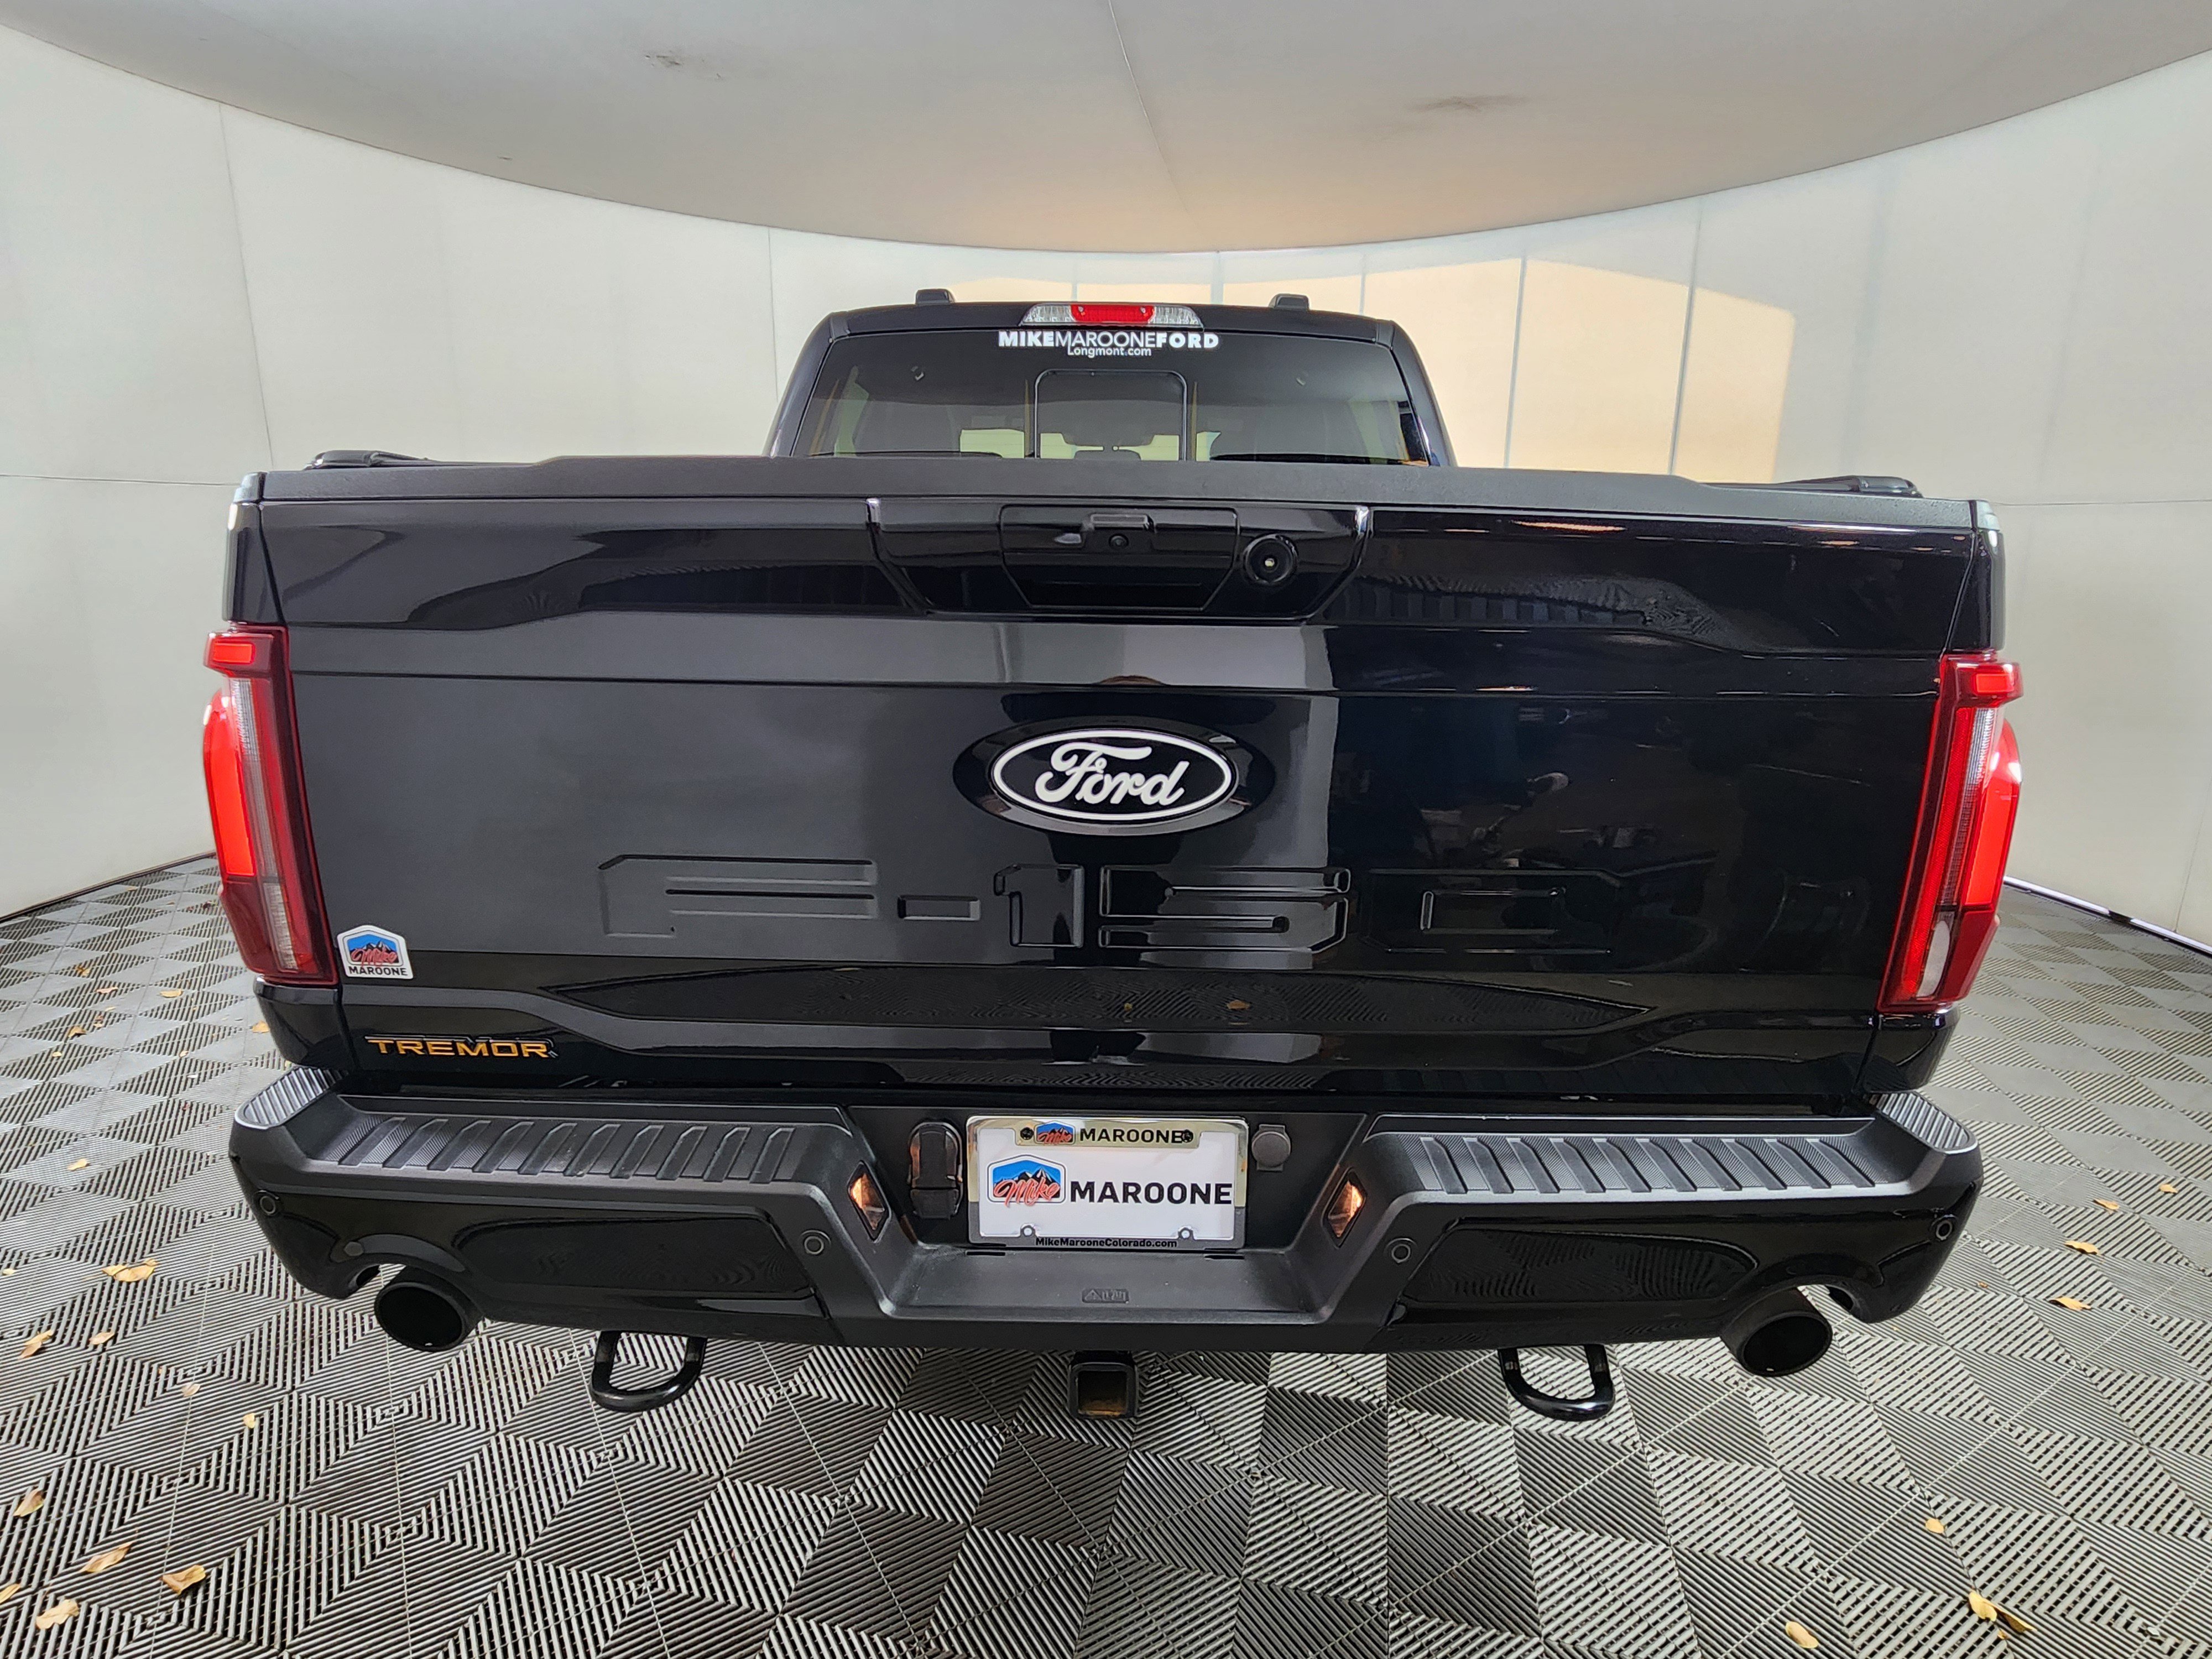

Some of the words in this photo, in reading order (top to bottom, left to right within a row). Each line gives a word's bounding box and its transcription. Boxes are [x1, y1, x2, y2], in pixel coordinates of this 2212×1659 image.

[998, 331, 1219, 348] MIKEMAROONEFORD
[1067, 345, 1151, 358] Longmont.com
[1035, 742, 1190, 806] Ford
[598, 854, 1620, 956] F-150
[351, 948, 398, 967] Mike
[348, 966, 408, 976] MAROONE
[366, 1037, 551, 1058] TREMOR
[1037, 1129, 1073, 1145] Mike
[1079, 1128, 1184, 1144] MAROONE
[993, 1176, 1061, 1207] Mike
[1070, 1181, 1233, 1205] MAROONE
[1035, 1238, 1177, 1248] MikeMarooneColorado.com
